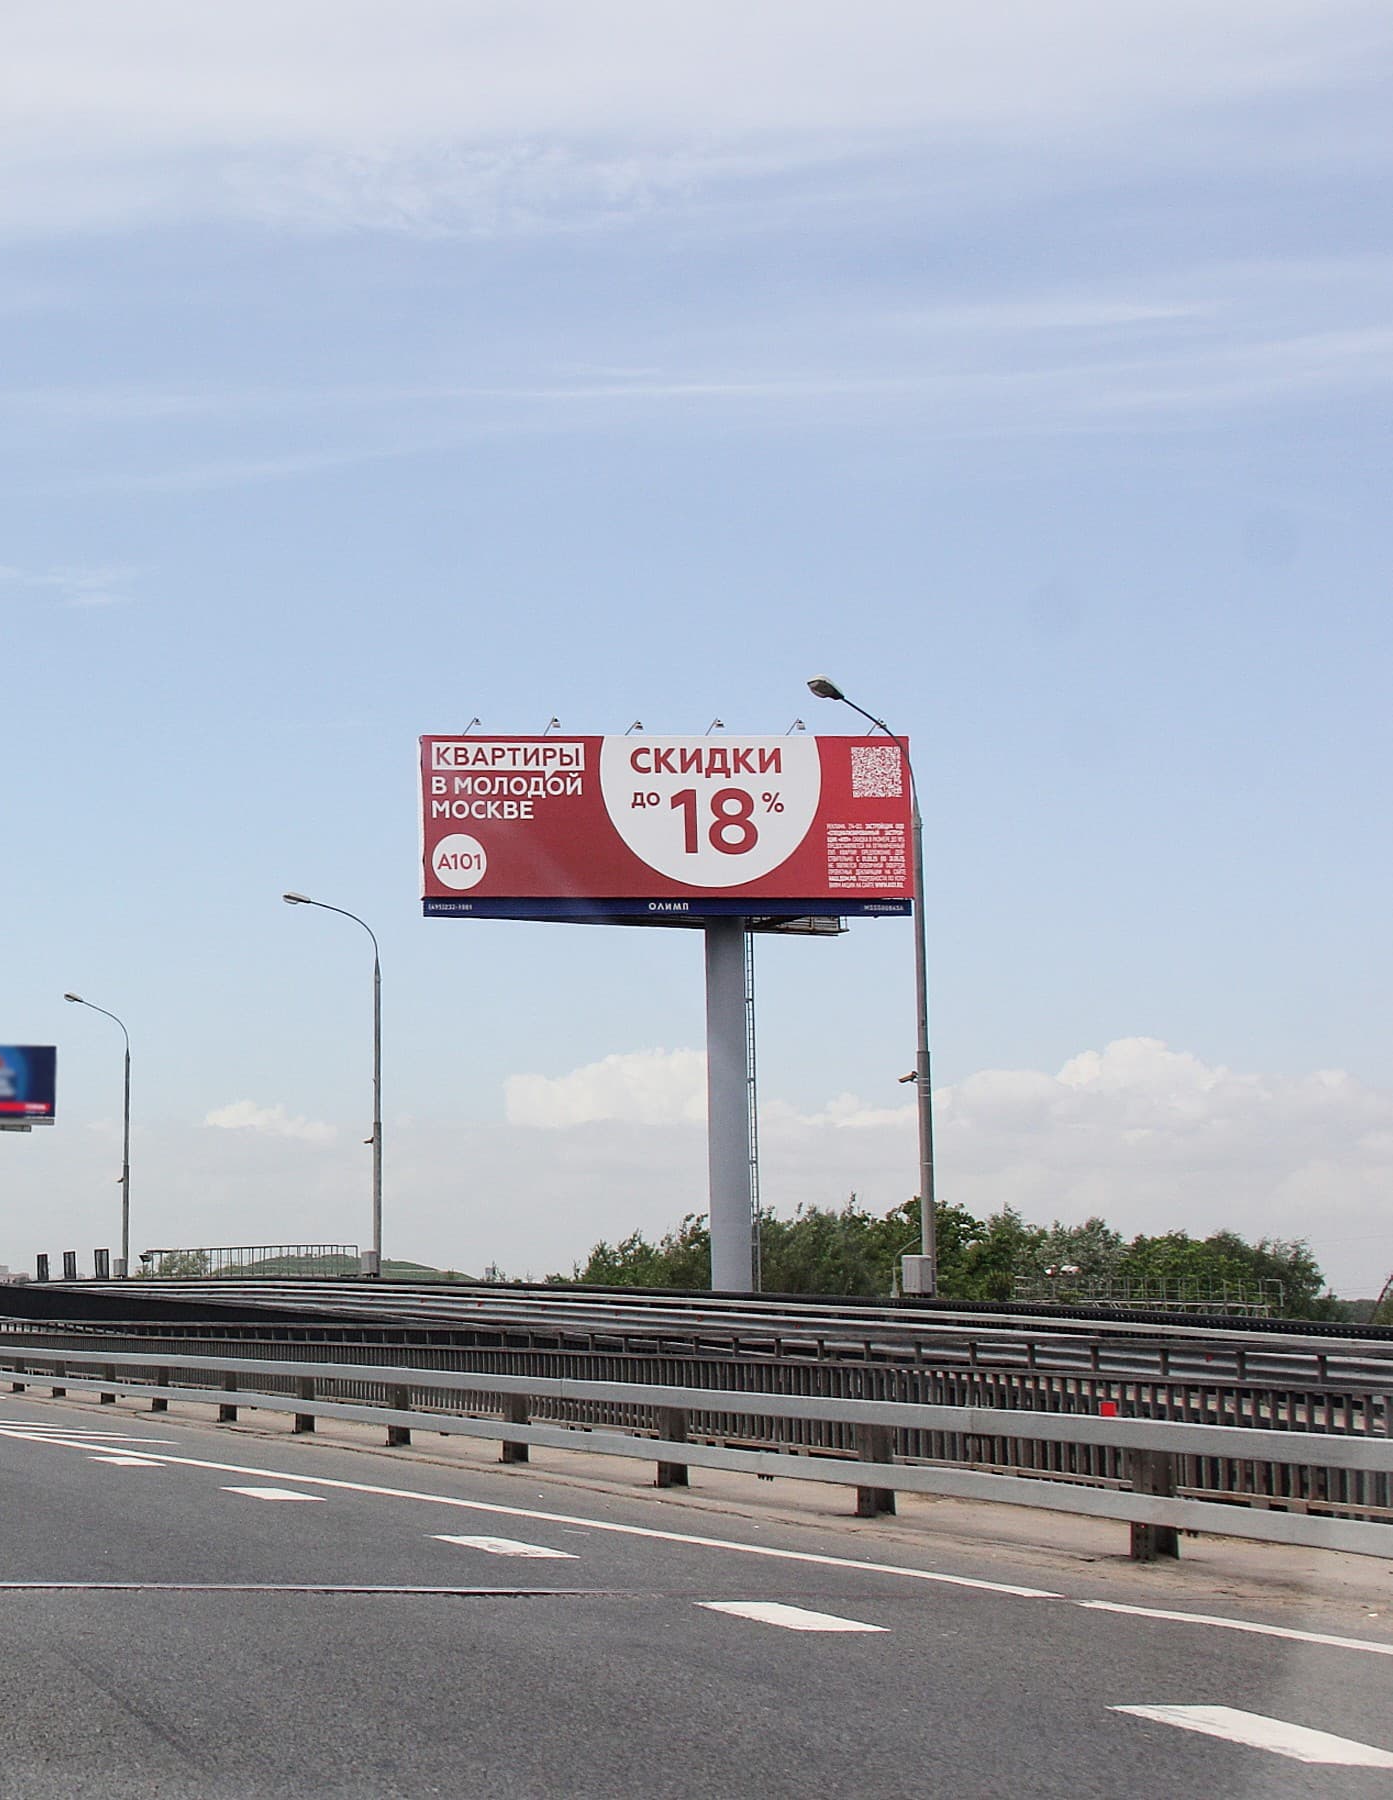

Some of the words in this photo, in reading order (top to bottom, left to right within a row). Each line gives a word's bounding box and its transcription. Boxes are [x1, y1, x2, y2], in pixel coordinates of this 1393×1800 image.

[436, 746, 580, 766] КВАРТИРЫ
[630, 747, 782, 779] СКИДКИ
[431, 776, 447, 795] В
[453, 772, 583, 799] МОЛОДОЙ
[431, 800, 535, 820] МОСКВЕ
[438, 853, 481, 870] А101
[648, 902, 689, 911] ОЛИМП
